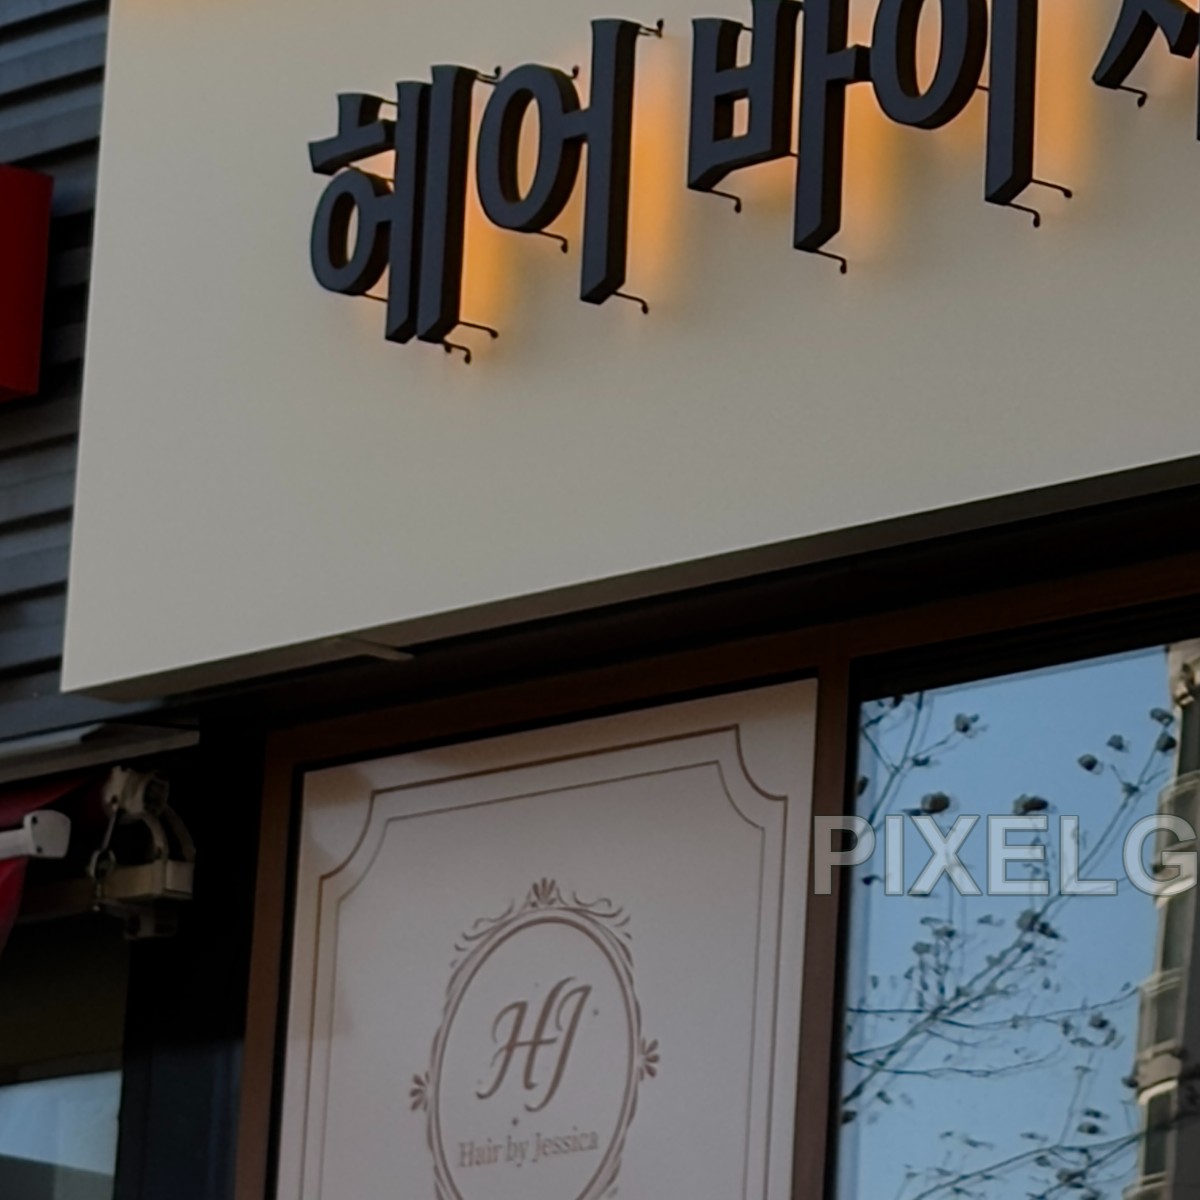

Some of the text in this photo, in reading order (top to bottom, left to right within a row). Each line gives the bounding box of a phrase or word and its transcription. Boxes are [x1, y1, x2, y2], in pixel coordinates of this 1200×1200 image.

[307, 17, 641, 344] 헤어
[457, 1125, 599, 1168] Hair by Jessica
